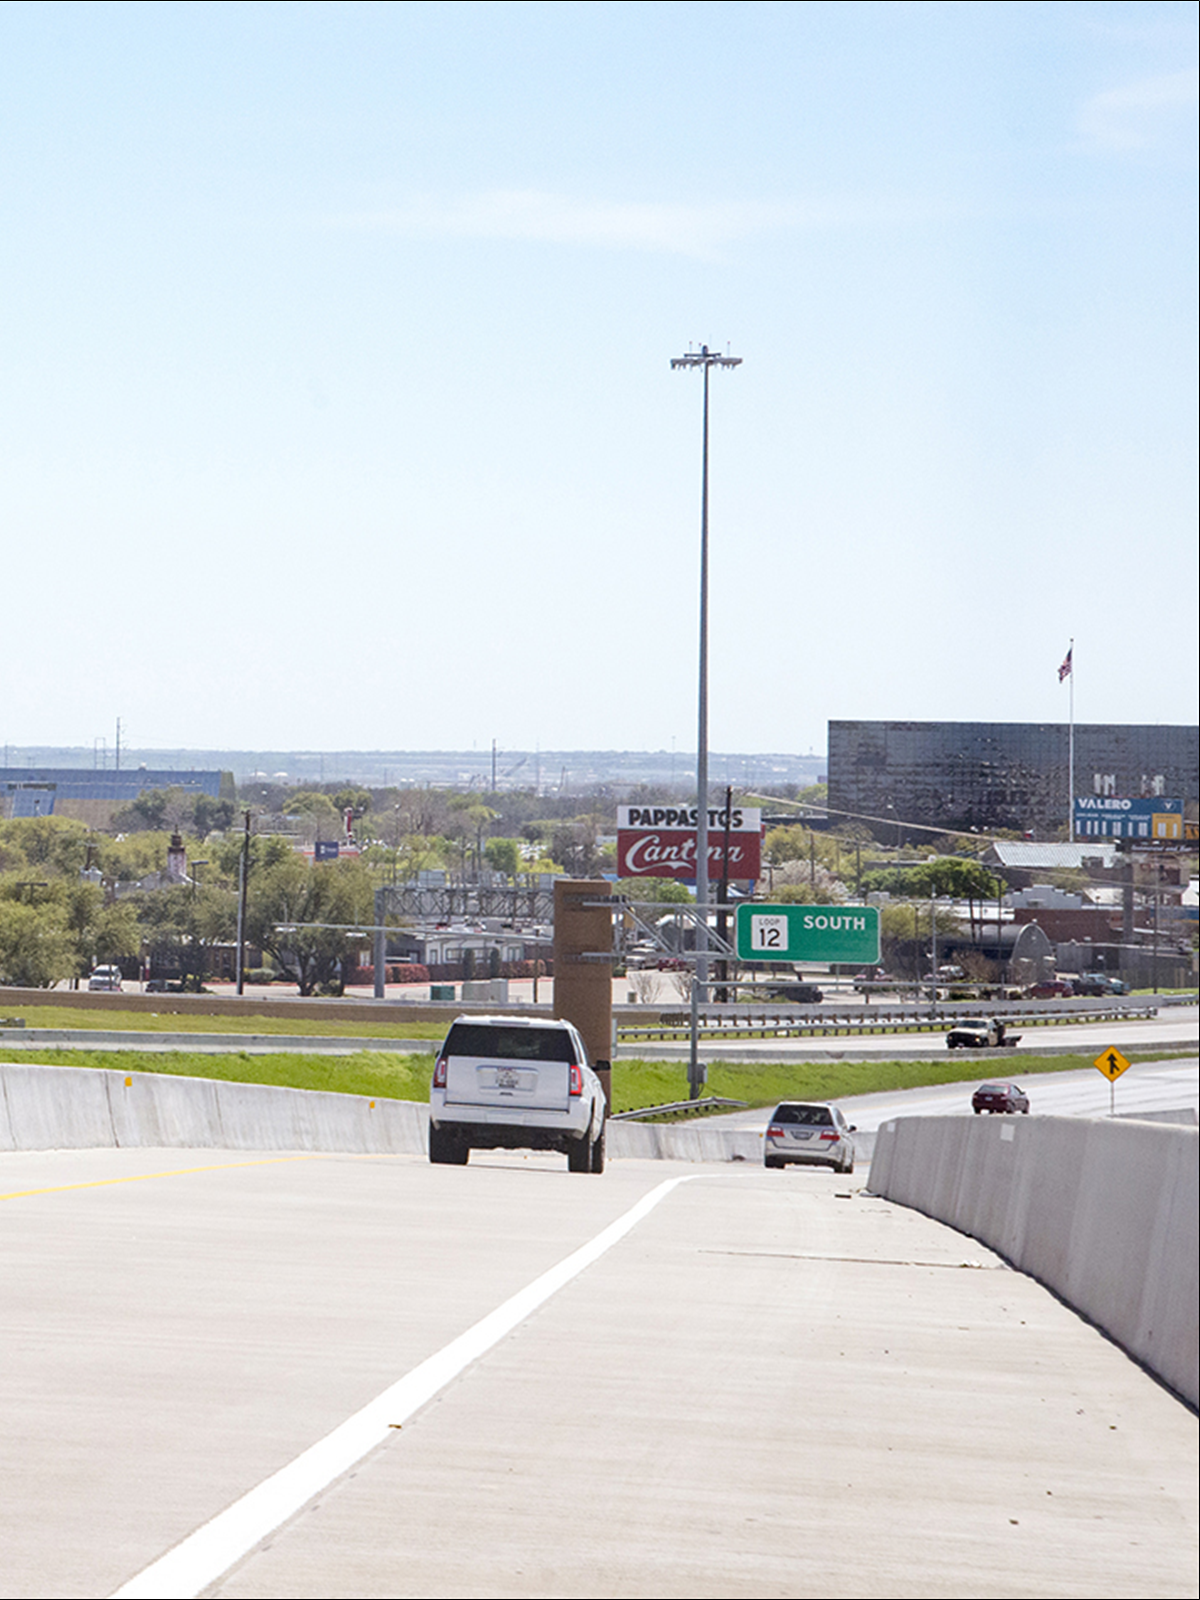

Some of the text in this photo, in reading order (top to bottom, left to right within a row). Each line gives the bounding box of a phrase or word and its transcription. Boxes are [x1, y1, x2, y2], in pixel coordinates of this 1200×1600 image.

[1078, 798, 1132, 810] VALERO
[628, 808, 743, 828] PAPPASTOS
[625, 834, 744, 872] Cantna
[759, 918, 781, 926] LOOP
[803, 915, 865, 931] SOUTH
[759, 928, 781, 947] 12
